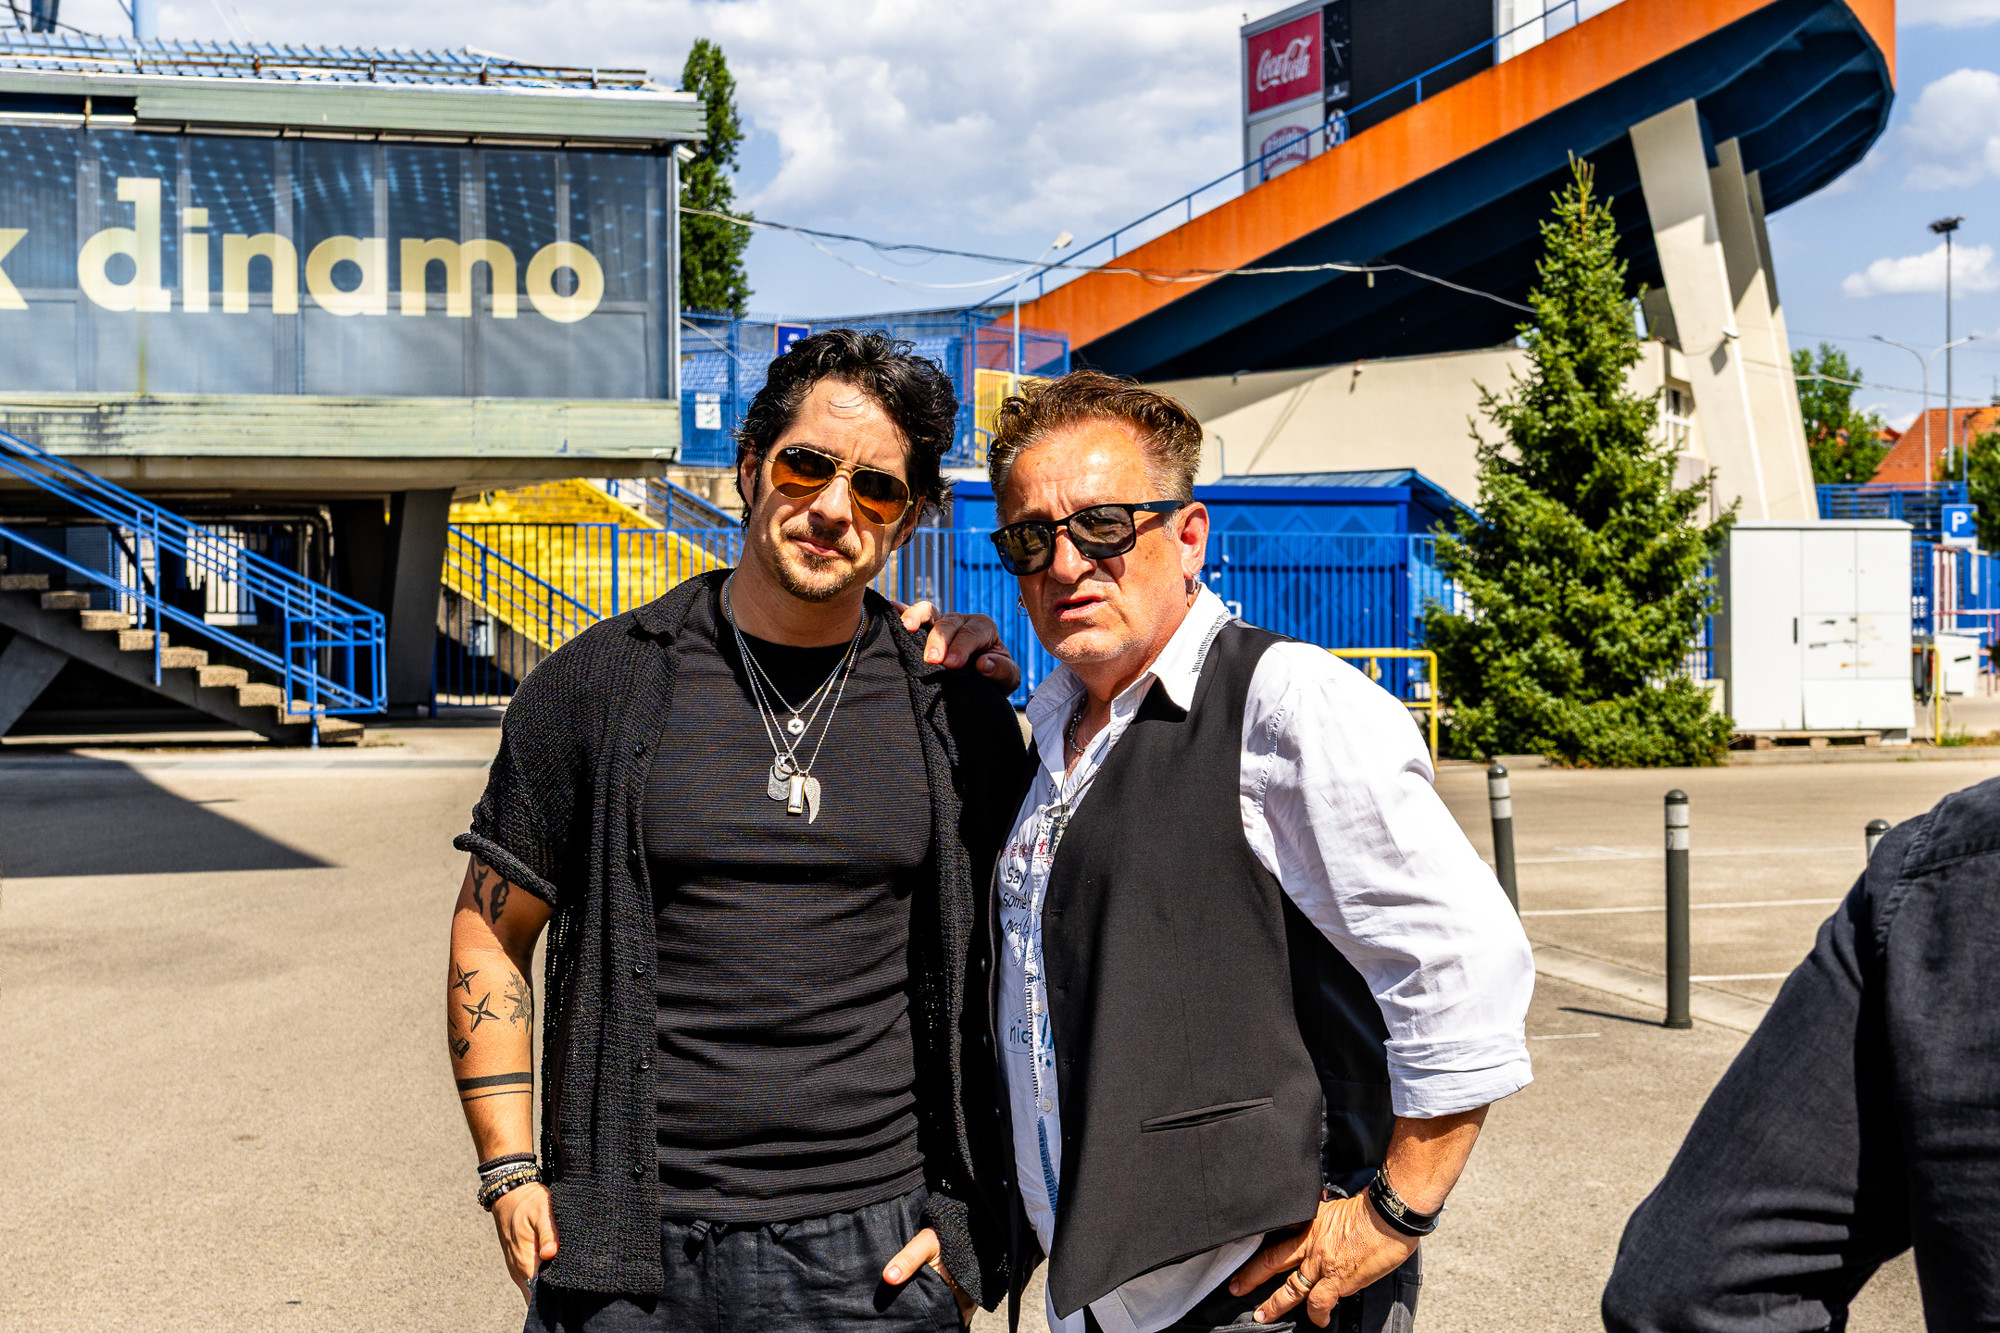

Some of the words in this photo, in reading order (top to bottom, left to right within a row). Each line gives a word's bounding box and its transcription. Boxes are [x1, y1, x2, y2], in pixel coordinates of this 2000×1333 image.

[1256, 35, 1313, 91] Coca-Cola
[77, 177, 605, 323] dinamo
[1951, 511, 1968, 532] P
